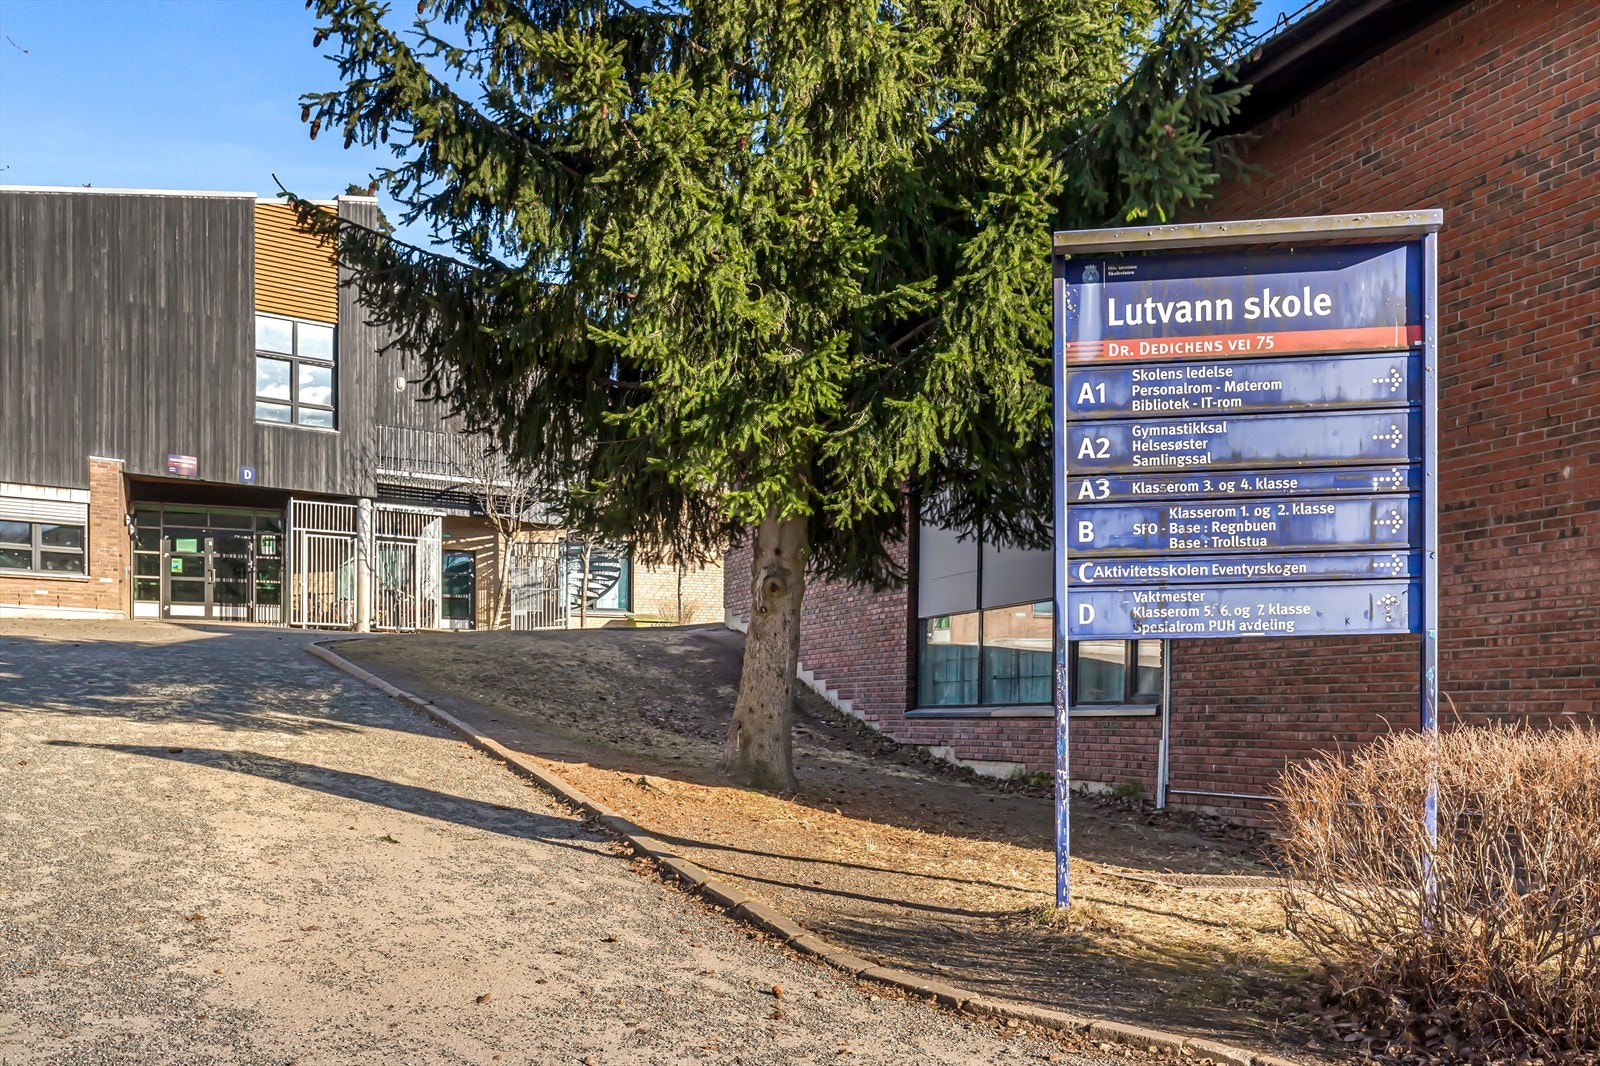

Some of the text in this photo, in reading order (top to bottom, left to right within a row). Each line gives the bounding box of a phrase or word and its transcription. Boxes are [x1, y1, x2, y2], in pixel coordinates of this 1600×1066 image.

[1108, 286, 1332, 326] Lutvann skole
[1257, 336, 1274, 350] 75
[1132, 366, 1233, 381] Skolens ledelse
[1077, 383, 1107, 404] A1
[1132, 381, 1212, 395] Personalrom
[1224, 379, 1282, 393] Møterom
[1132, 398, 1190, 411] Bibliotek
[1201, 396, 1242, 409] IT-rom
[1132, 421, 1227, 438] Gymnastikksal
[1077, 438, 1110, 459] A2
[1132, 438, 1208, 452] Helsesøster
[1132, 452, 1211, 468] Samlingssal
[244, 470, 252, 479] D
[1077, 479, 1110, 500] A3
[1132, 476, 1298, 494] Klasserom 3. og 4. klasse
[1169, 502, 1335, 519] Klasserom 1. og 2. klasse
[1078, 521, 1094, 543] B
[1132, 523, 1158, 535] SFO
[1169, 521, 1200, 534] Base
[1211, 519, 1276, 536] Regnbuen
[1169, 536, 1200, 549] Base
[1211, 535, 1267, 548] Trollstua
[1078, 562, 1093, 584] C
[1093, 562, 1306, 580] Aktivitetsskolen Eventyrskogen
[1133, 591, 1206, 604] Vaktmester
[1078, 604, 1095, 625] D
[1132, 605, 1200, 619] Klasserom
[1221, 605, 1232, 617] 6.
[1234, 605, 1250, 618] og
[1257, 604, 1265, 616] 7.
[1268, 603, 1311, 616] klasse
[1132, 617, 1295, 636] Spesialrom PUH avdeling
